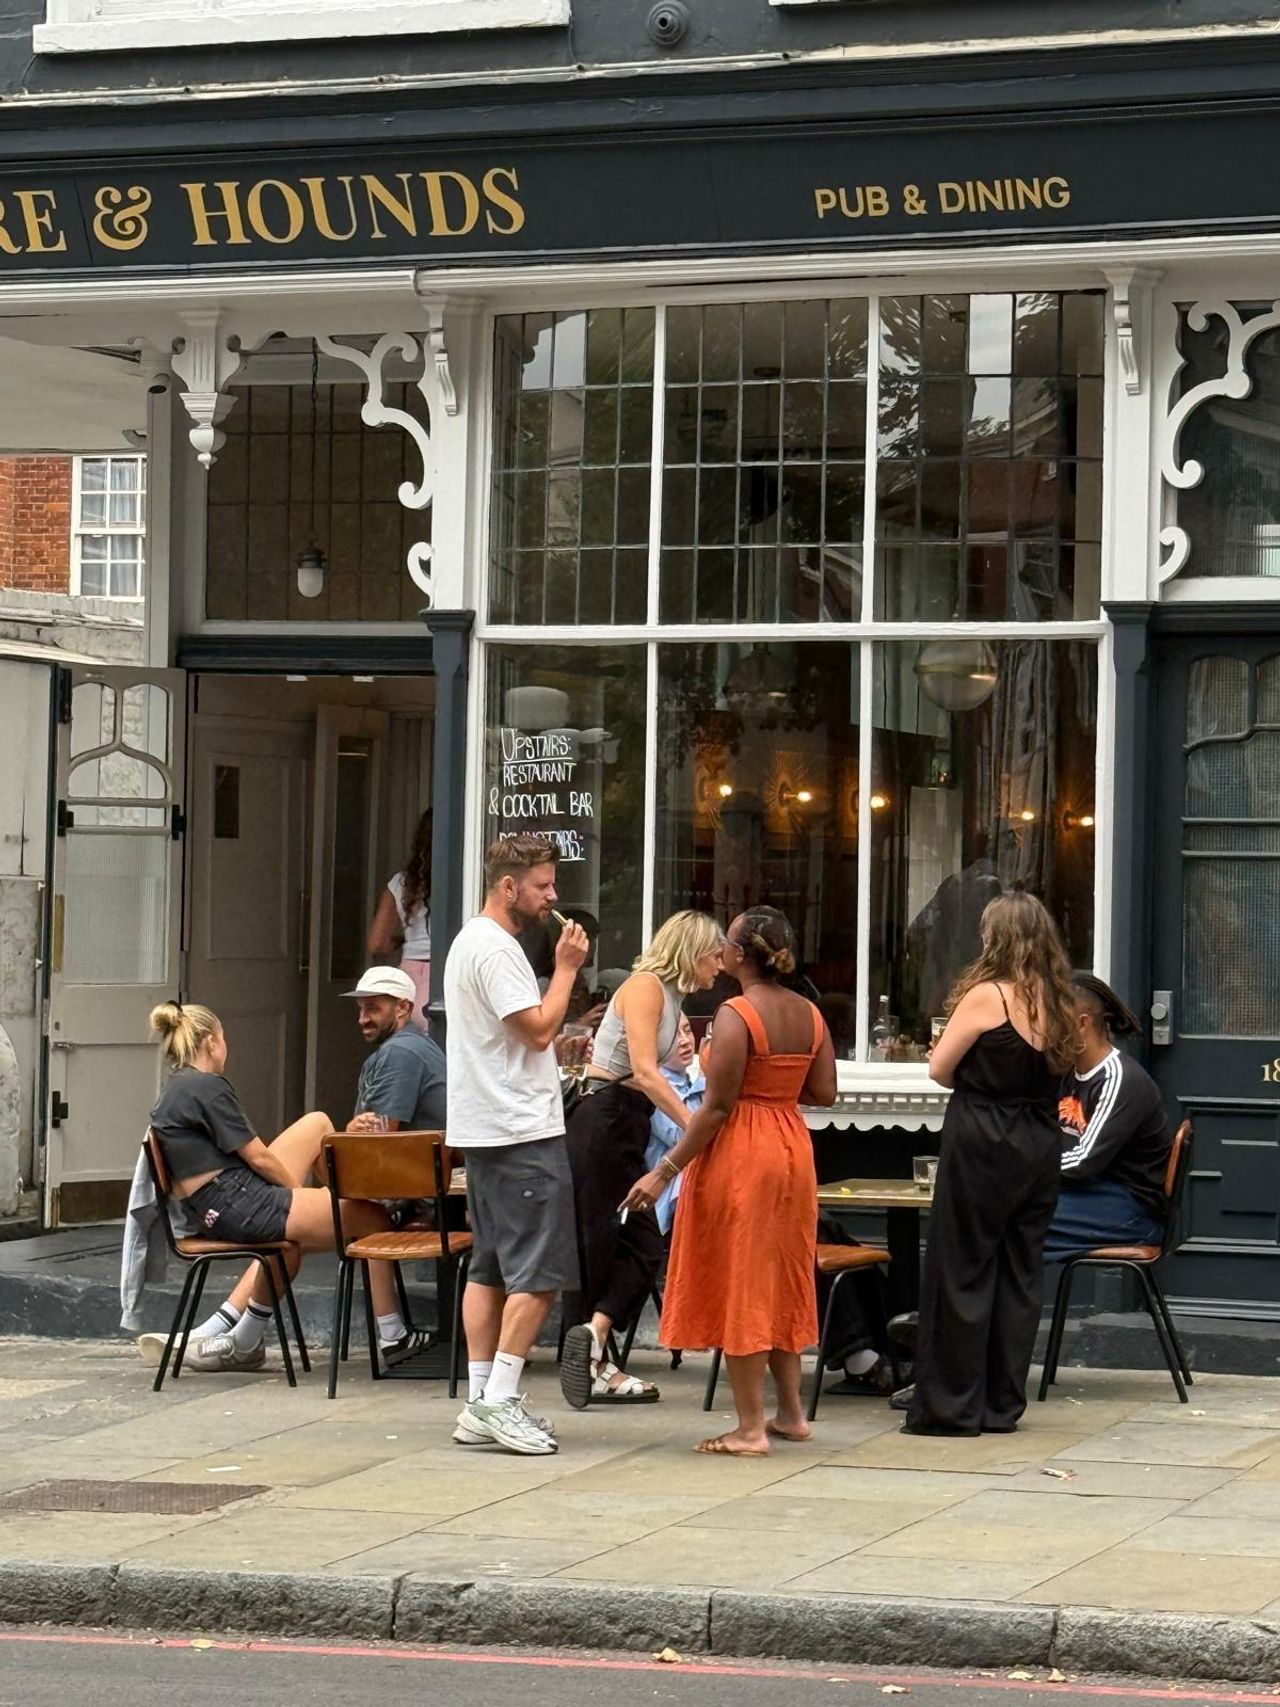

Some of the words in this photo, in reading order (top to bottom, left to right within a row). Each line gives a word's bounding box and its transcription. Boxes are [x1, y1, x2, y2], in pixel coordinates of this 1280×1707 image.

[93, 186, 152, 250] &
[180, 167, 525, 245] HOUNDS
[814, 186, 890, 219] PUB
[903, 184, 928, 216] &
[938, 176, 1071, 214] DINING
[503, 761, 577, 787] RESTAURANT
[488, 786, 499, 815] &
[502, 793, 565, 818] COCKTAIL
[570, 791, 594, 818] BAR
